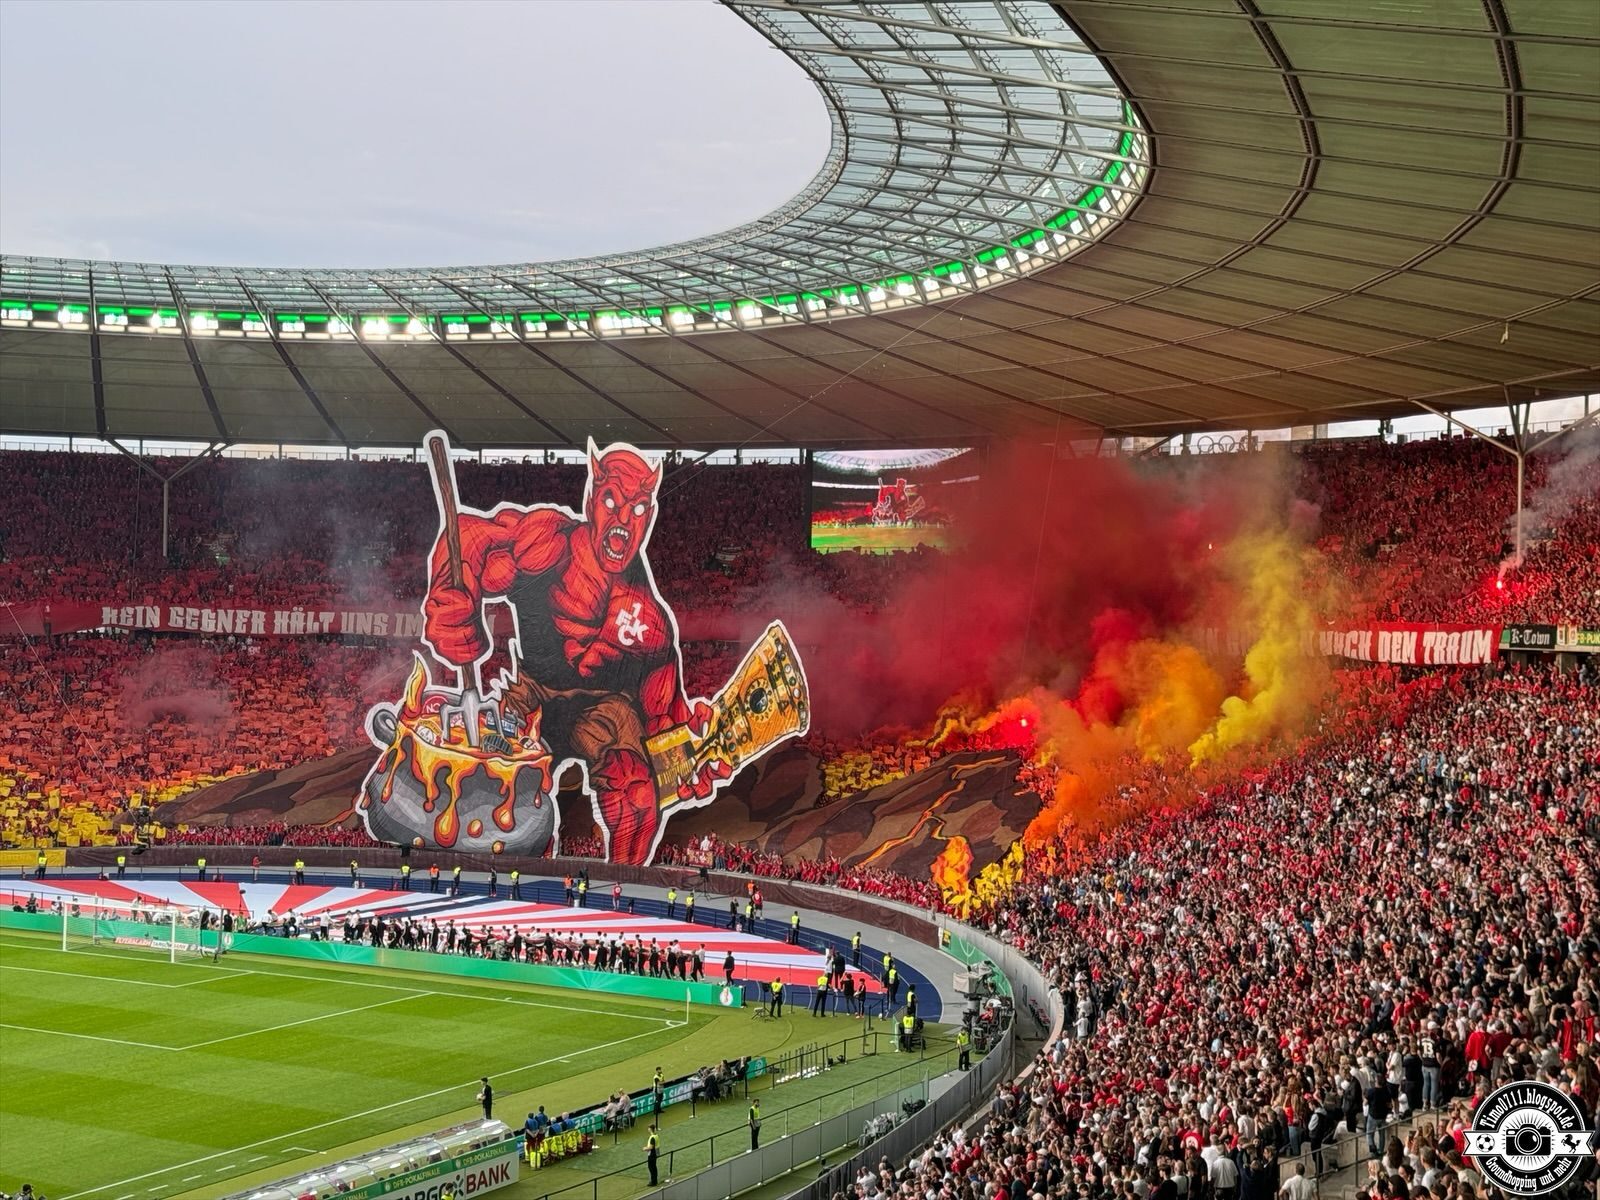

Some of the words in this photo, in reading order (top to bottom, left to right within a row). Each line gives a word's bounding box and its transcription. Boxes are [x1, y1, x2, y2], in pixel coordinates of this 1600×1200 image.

[102, 606, 160, 628] KEIN
[168, 606, 266, 634] GEGNER
[273, 606, 335, 635] HÄLT
[341, 612, 389, 636] UNS
[1422, 629, 1493, 664] TRAUM
[1511, 628, 1550, 645] K-Town
[1421, 1042, 1435, 1058] 13
[466, 1160, 511, 1195] BANK
